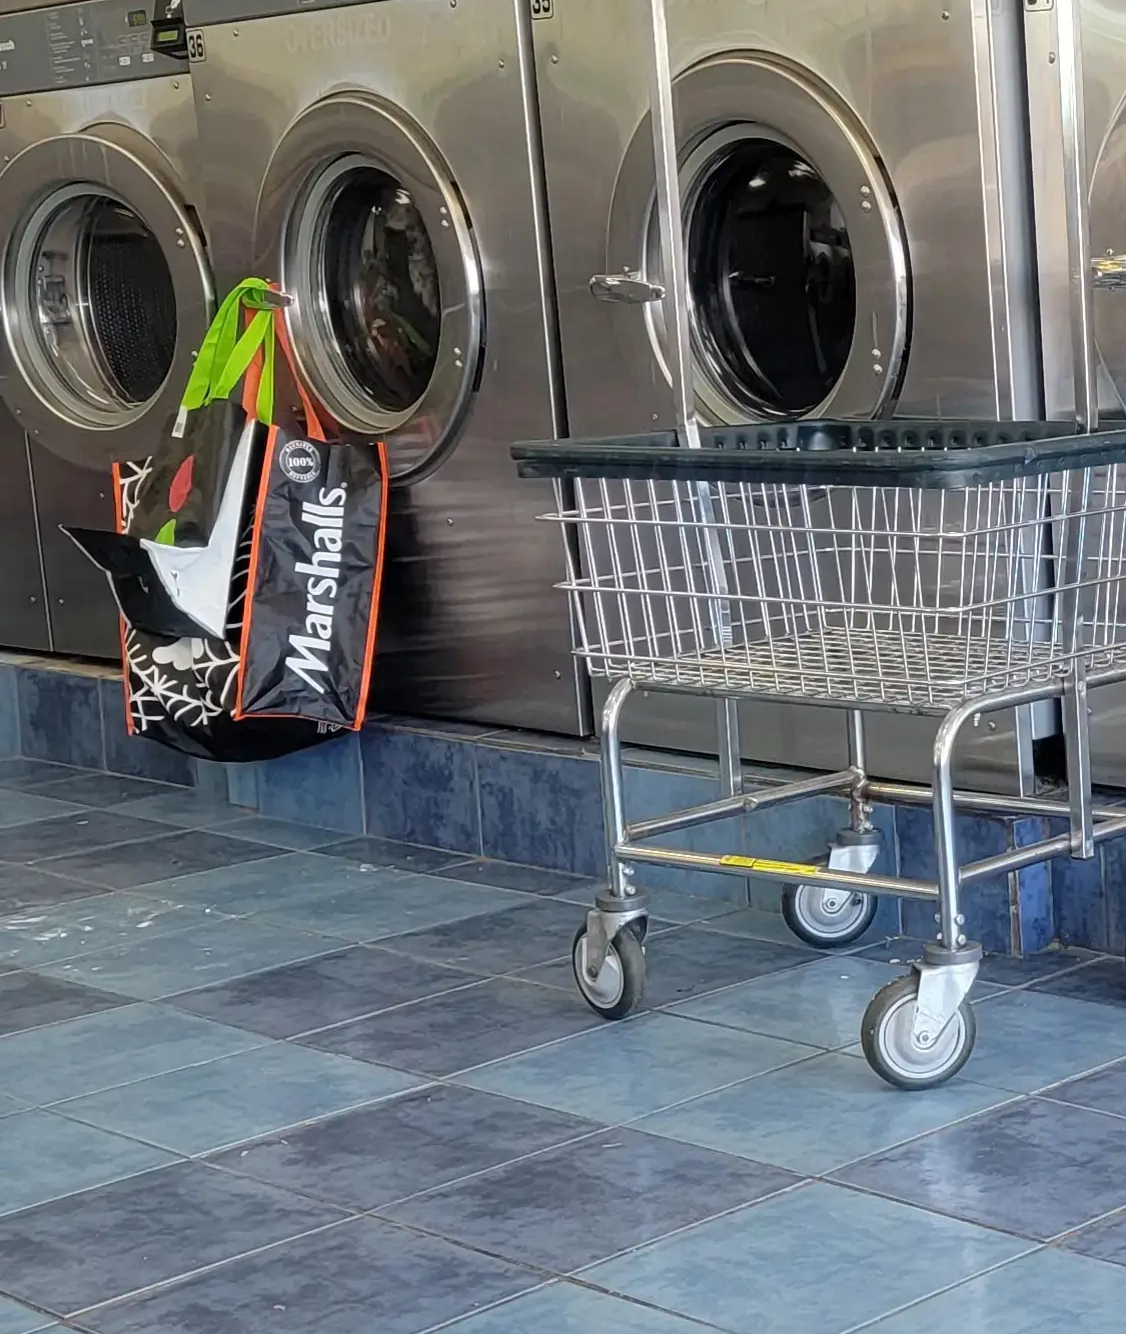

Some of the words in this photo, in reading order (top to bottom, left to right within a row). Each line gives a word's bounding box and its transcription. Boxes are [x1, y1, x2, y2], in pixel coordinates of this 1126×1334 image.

[188, 33, 204, 58] 36
[288, 457, 315, 467] 100%
[284, 486, 348, 695] Marshalls
